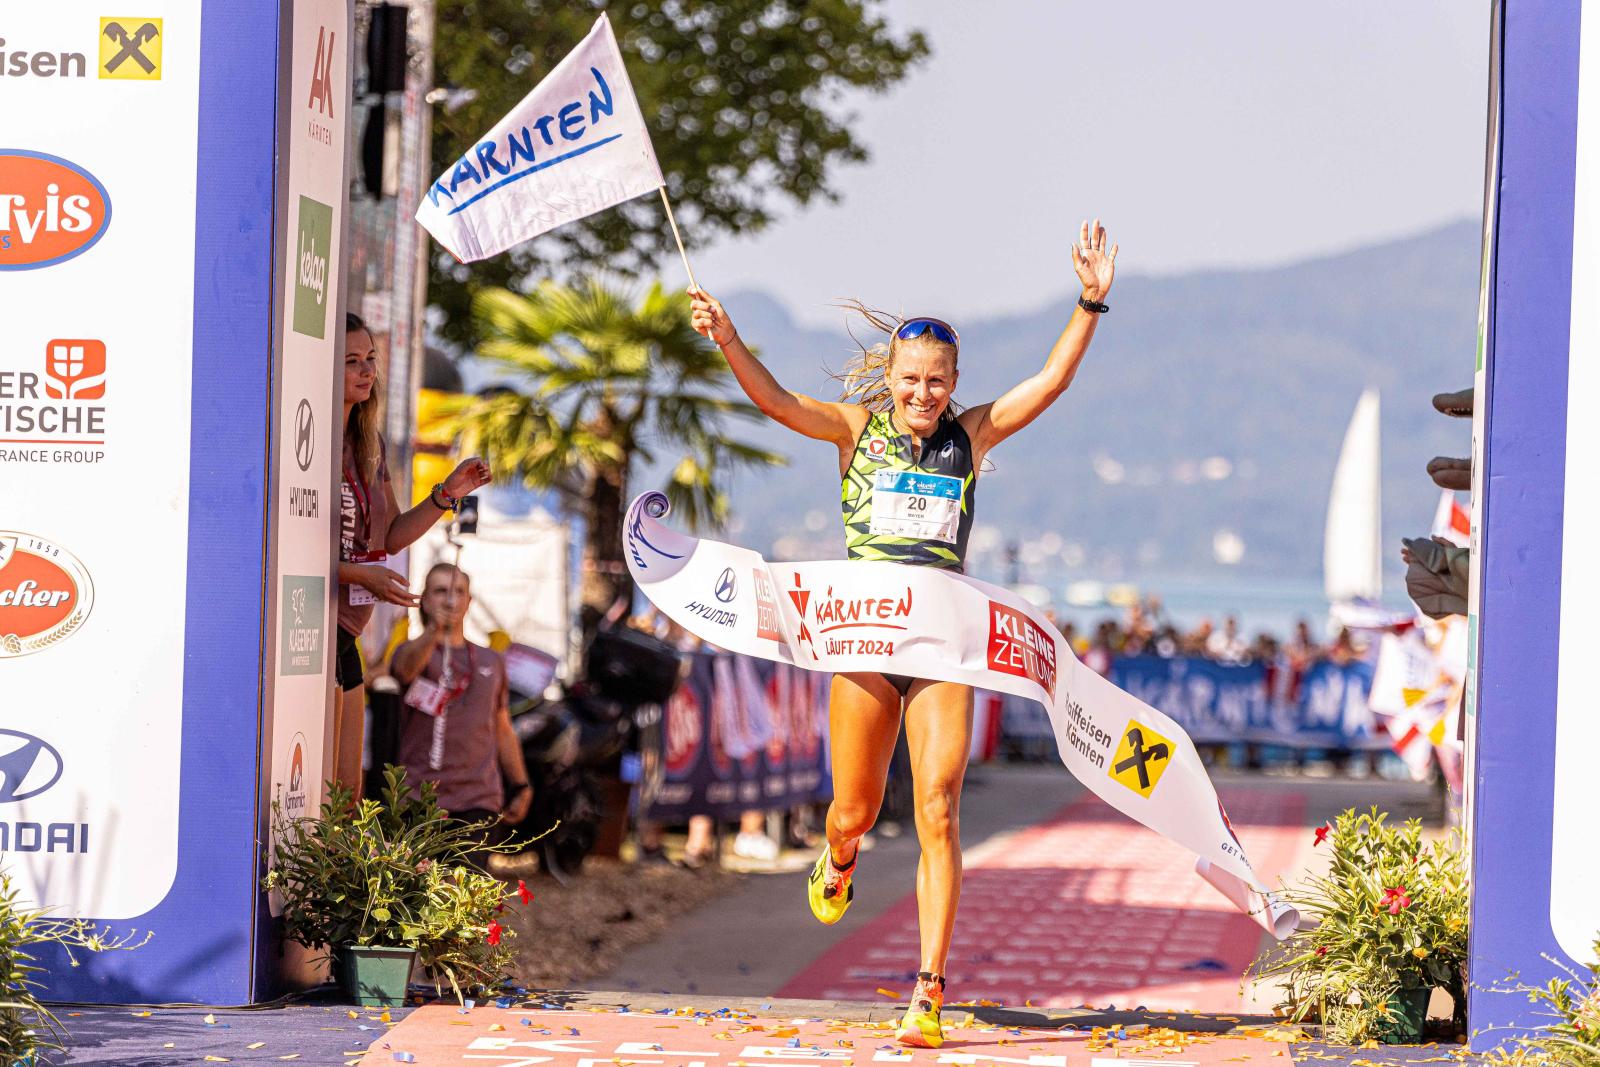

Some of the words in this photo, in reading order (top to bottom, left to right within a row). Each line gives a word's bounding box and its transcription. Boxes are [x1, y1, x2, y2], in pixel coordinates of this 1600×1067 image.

[308, 25, 335, 119] AK
[299, 230, 326, 305] kelag
[0, 405, 106, 434] ISCHE
[53, 450, 105, 464] GROUP
[289, 486, 319, 519] HYUNDAI
[907, 496, 927, 511] 20
[29, 539, 60, 557] 1858
[684, 601, 739, 628] HYUNDAI
[815, 585, 913, 625] KÄRNTEN
[825, 638, 855, 656] LÄUFT
[857, 640, 894, 656] 2024
[995, 611, 1056, 668] KLEINE
[1066, 720, 1105, 769] Kärnten
[1221, 842, 1238, 857] GET
